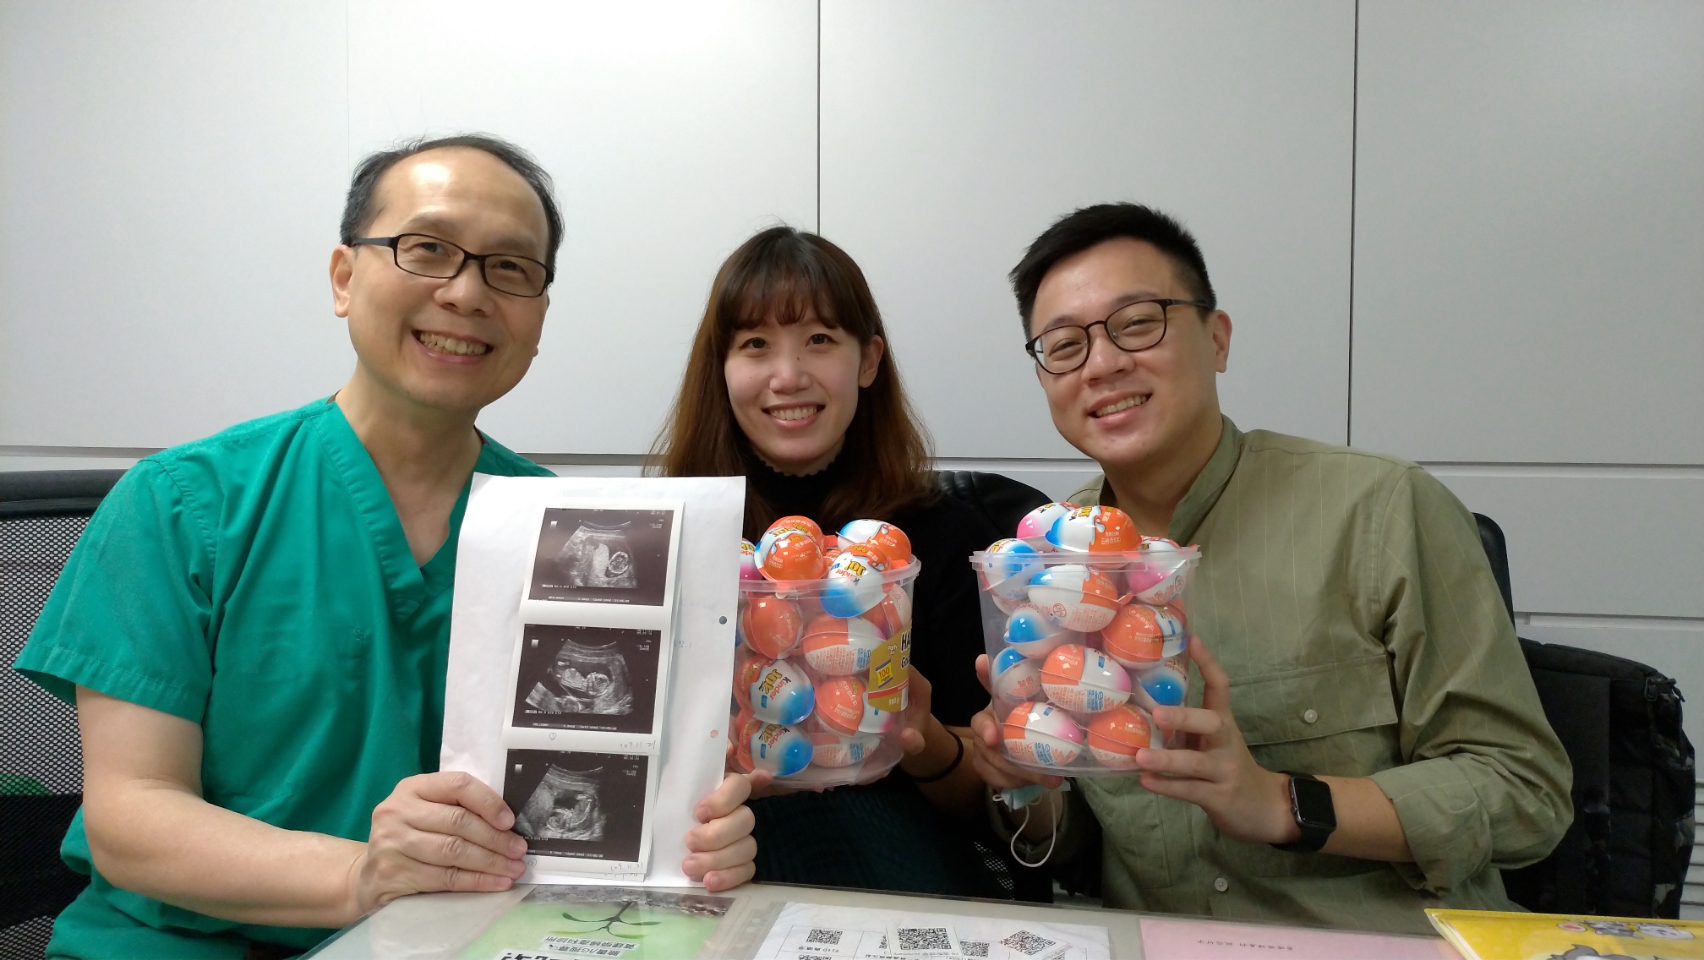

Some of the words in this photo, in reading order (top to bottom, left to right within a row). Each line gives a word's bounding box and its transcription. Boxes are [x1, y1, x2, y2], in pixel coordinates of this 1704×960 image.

[878, 666, 891, 680] 100
[769, 676, 792, 701] Kinder
[768, 725, 791, 749] Kinder
